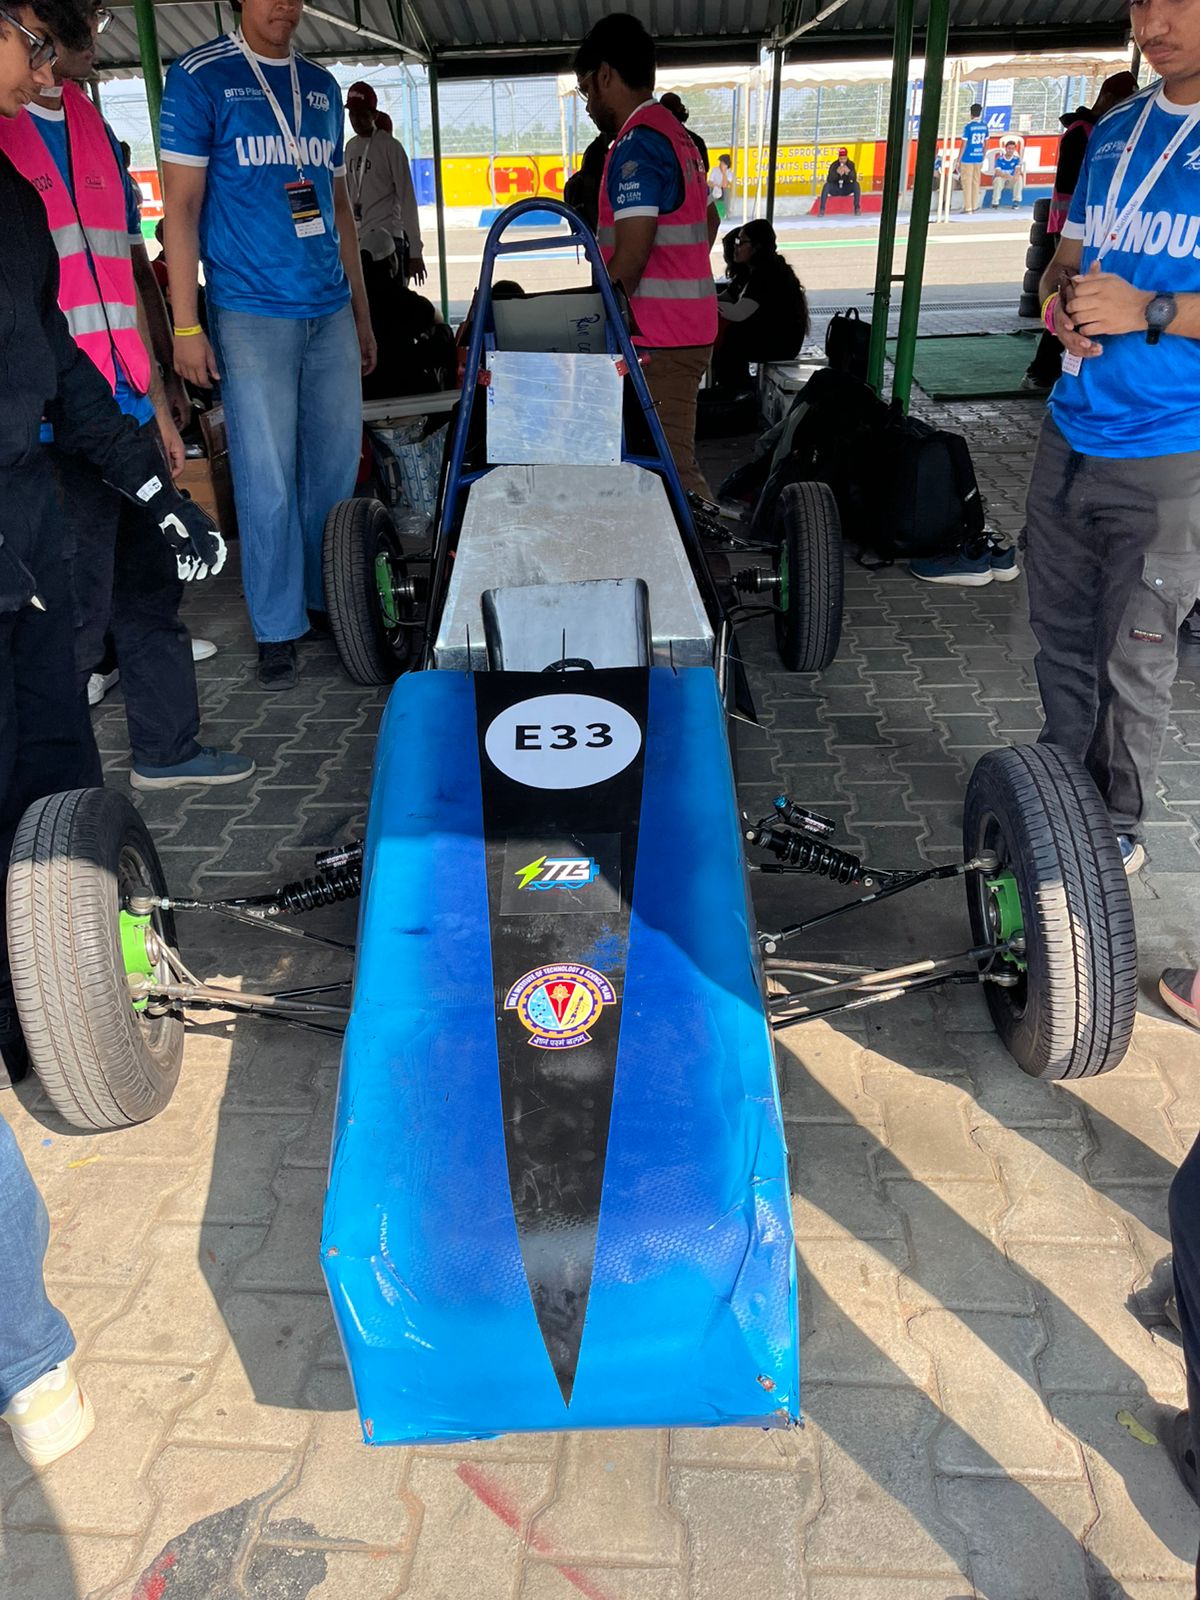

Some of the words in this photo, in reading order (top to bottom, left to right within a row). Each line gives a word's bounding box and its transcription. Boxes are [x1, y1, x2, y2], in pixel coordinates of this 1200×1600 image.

[224, 87, 245, 98] BITS
[235, 135, 335, 172] LUMNOU
[515, 722, 614, 750] E33
[515, 975, 536, 994] INSTITUTE
[536, 970, 544, 978] OF
[544, 966, 580, 975] TECHNOLOGY
[585, 971, 604, 987] SCIENCE
